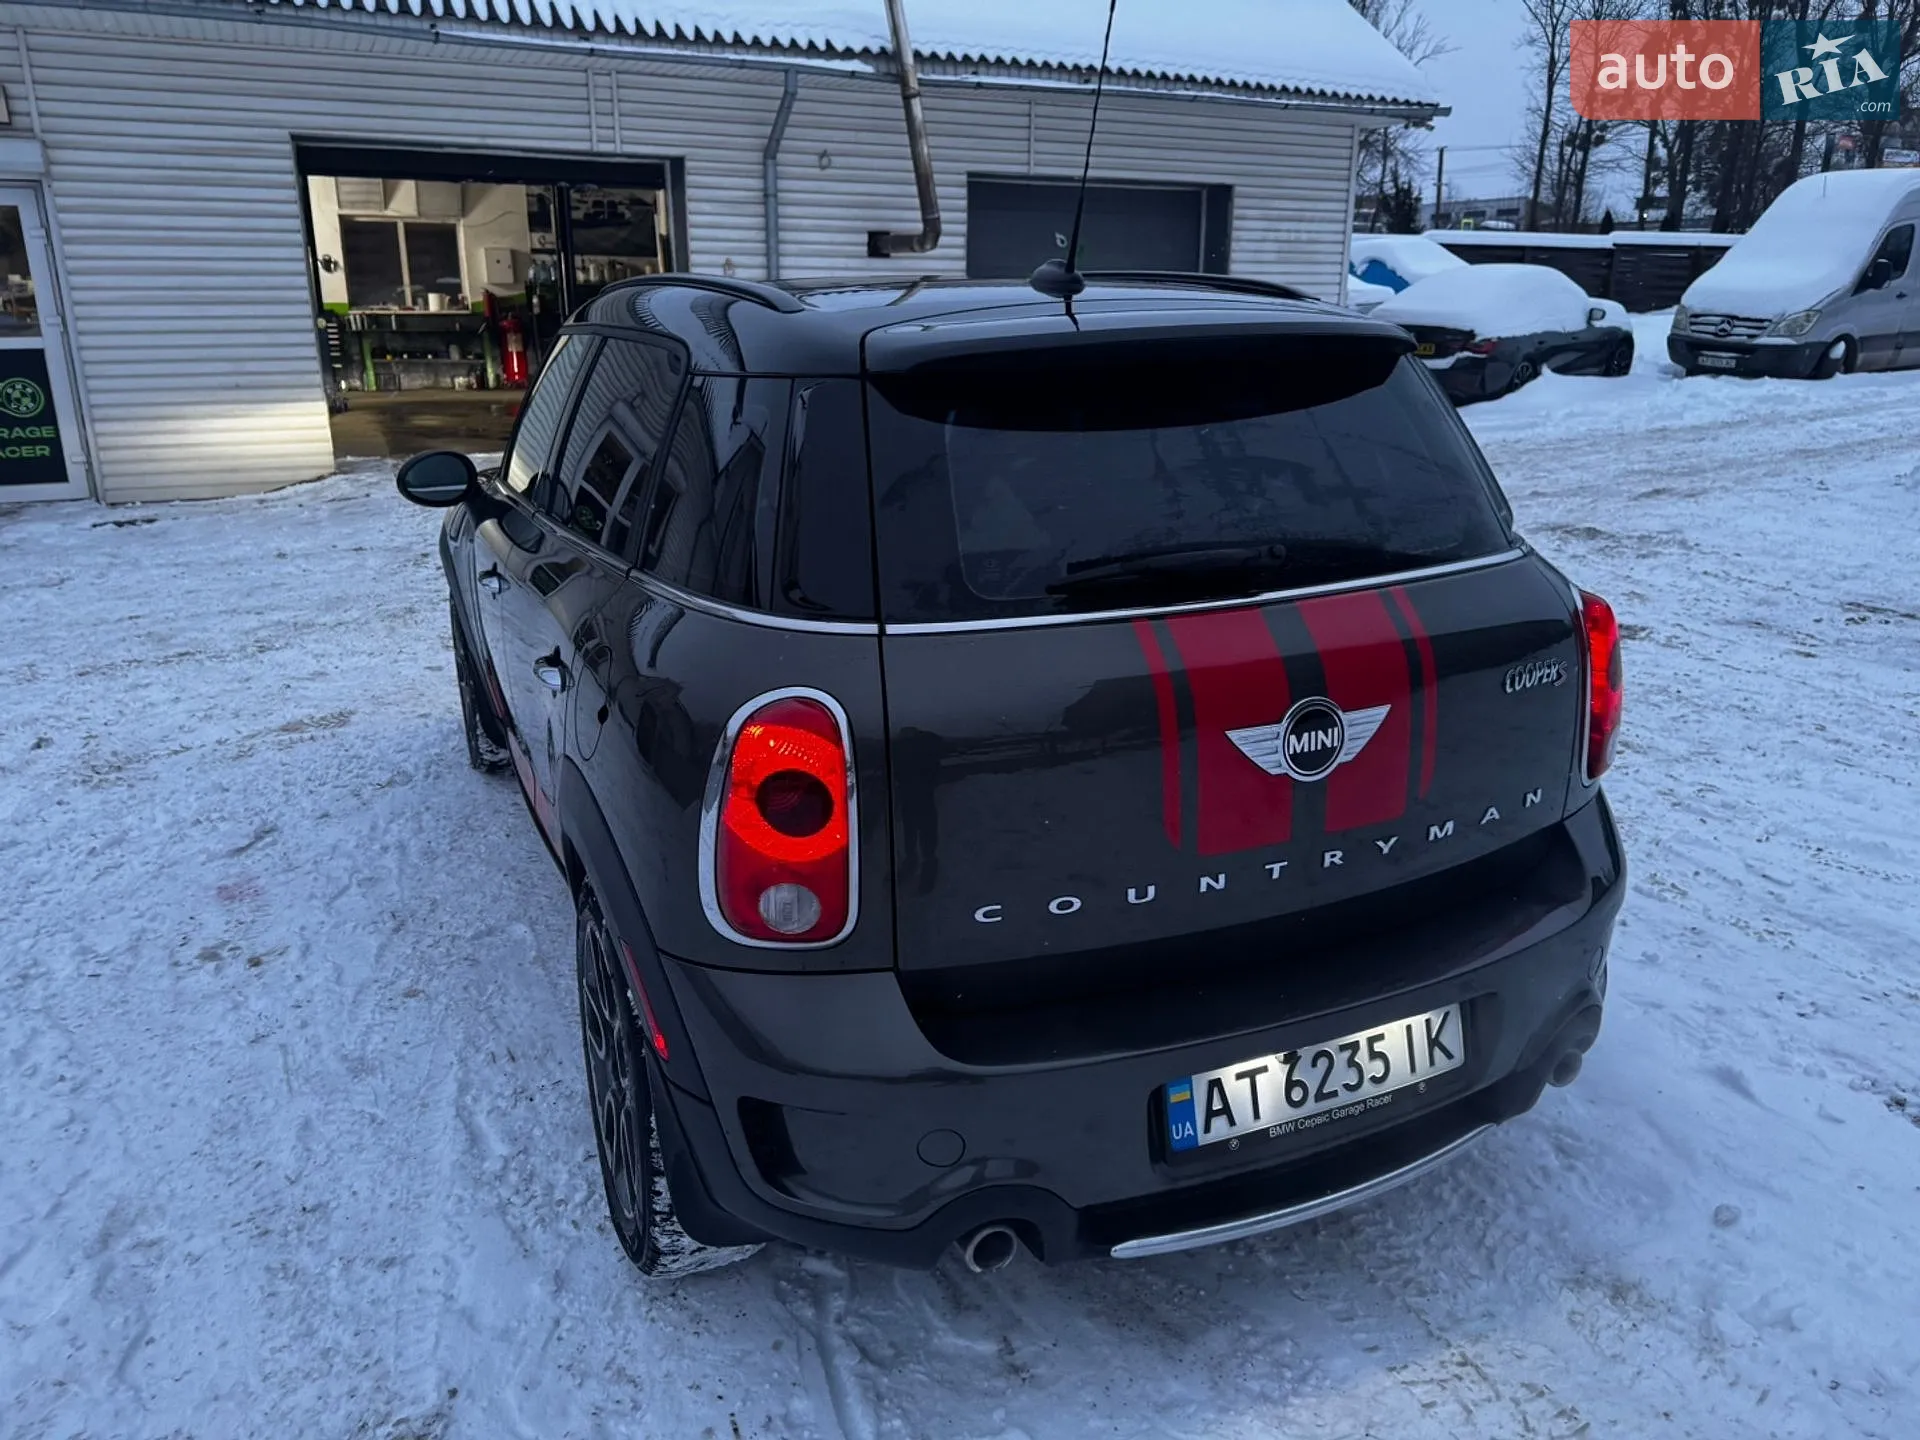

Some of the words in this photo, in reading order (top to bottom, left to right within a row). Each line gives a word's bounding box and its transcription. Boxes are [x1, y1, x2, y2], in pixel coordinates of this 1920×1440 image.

[1289, 727, 1339, 755] MINI
[974, 788, 1542, 923] COUNTRYMAN
[1203, 1064, 1269, 1134] AT
[1281, 1032, 1391, 1109] 6235
[1172, 1123, 1195, 1140] UA
[1269, 1121, 1297, 1138] BMW
[1331, 1103, 1366, 1121] Garage
[1366, 1094, 1393, 1110] Racer
